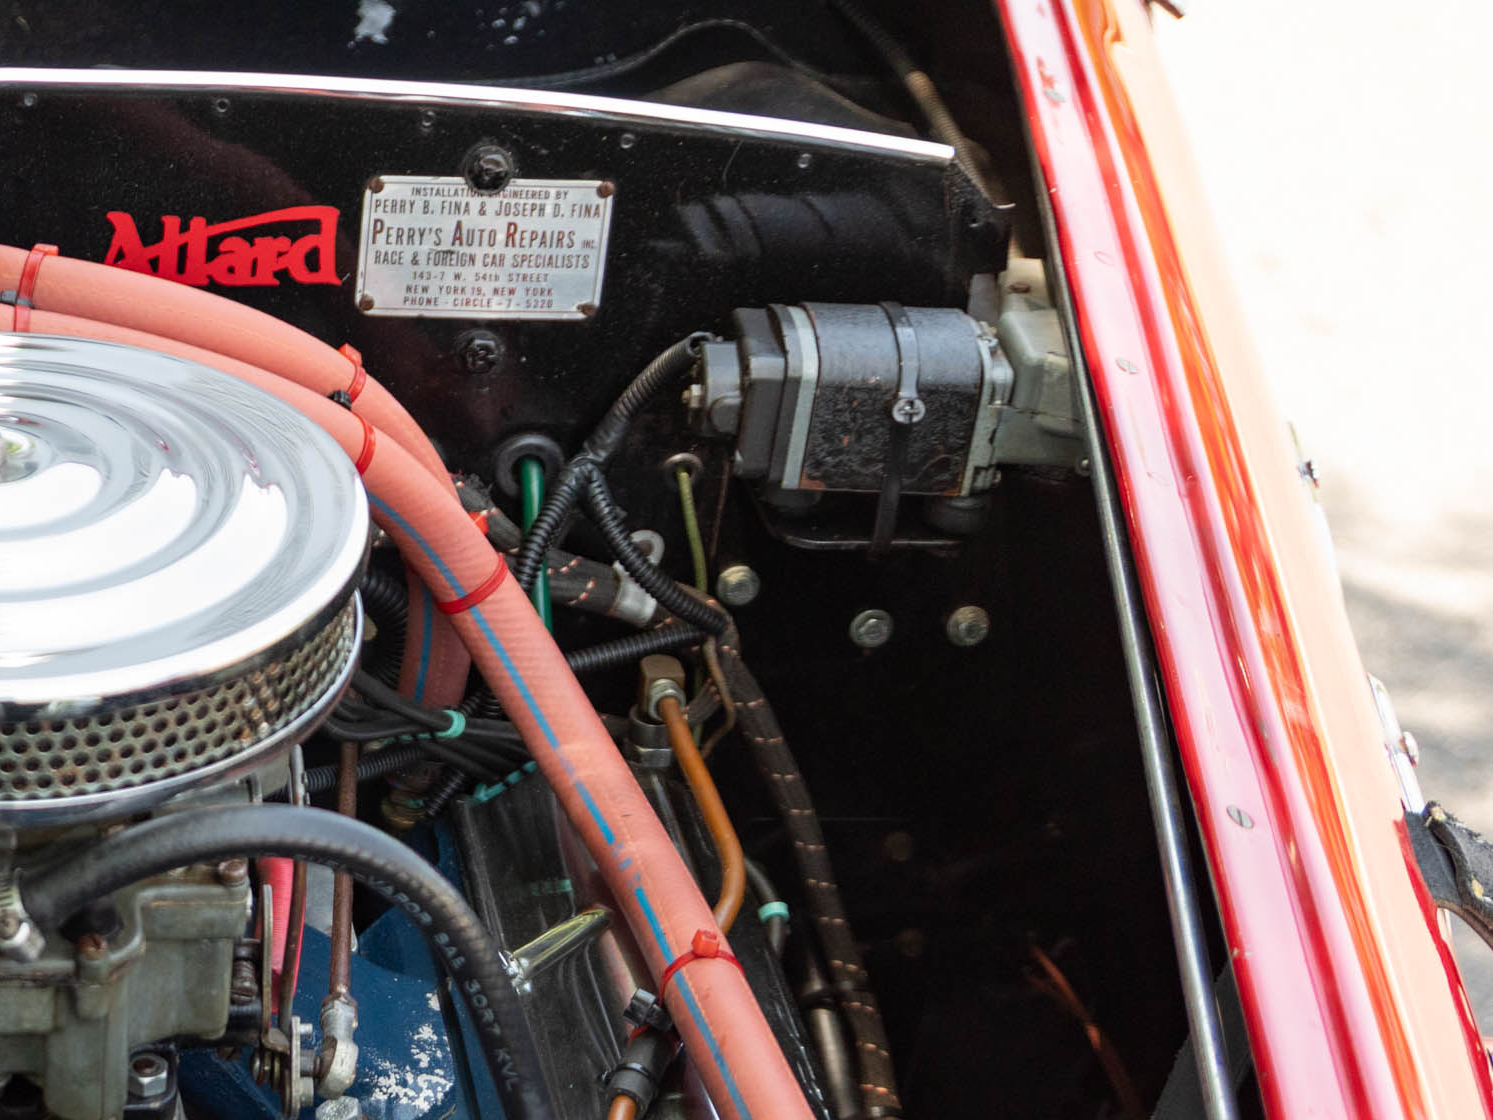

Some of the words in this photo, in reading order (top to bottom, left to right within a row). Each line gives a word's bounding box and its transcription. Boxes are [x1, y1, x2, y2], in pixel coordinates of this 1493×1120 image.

[489, 189, 550, 200] GINEERED
[555, 190, 569, 200] BY
[373, 199, 416, 214] PERRY
[422, 200, 435, 215] B.
[440, 201, 471, 216] FINA
[478, 201, 488, 216] &
[494, 201, 547, 217] JOSEPH
[570, 203, 601, 218] FINA
[451, 219, 498, 248] AUTO
[505, 221, 576, 248] REPAIRS
[373, 250, 404, 265] RACE
[410, 250, 420, 266] &
[425, 250, 477, 267] FOREIGN
[482, 253, 506, 268] CAR
[512, 254, 590, 269] SPECIALISTS
[453, 271, 466, 281] W.
[507, 273, 549, 283] STREET
[405, 284, 429, 294] NEW
[438, 285, 467, 295] YORK
[492, 287, 518, 297] NEW
[525, 287, 554, 297] YORK
[403, 296, 439, 306] PHONE
[452, 298, 493, 308] CIRCLE
[433, 931, 466, 969] SAE
